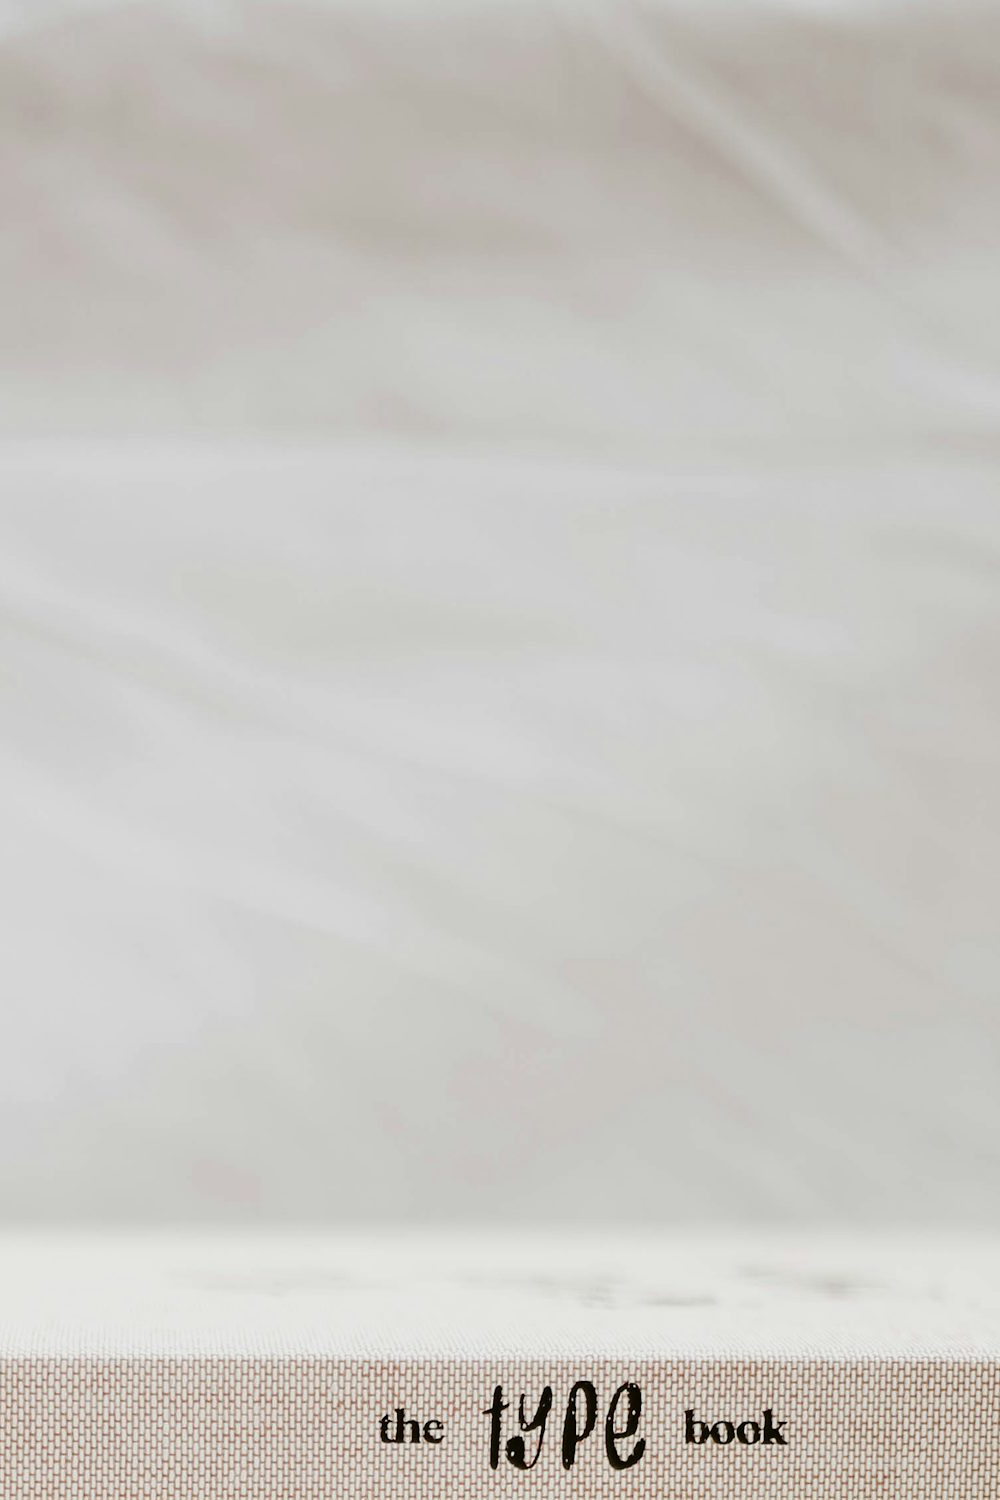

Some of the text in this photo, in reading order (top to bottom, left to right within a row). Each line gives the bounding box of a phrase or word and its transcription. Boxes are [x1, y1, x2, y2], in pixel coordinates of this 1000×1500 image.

[378, 1380, 789, 1471] the type book
